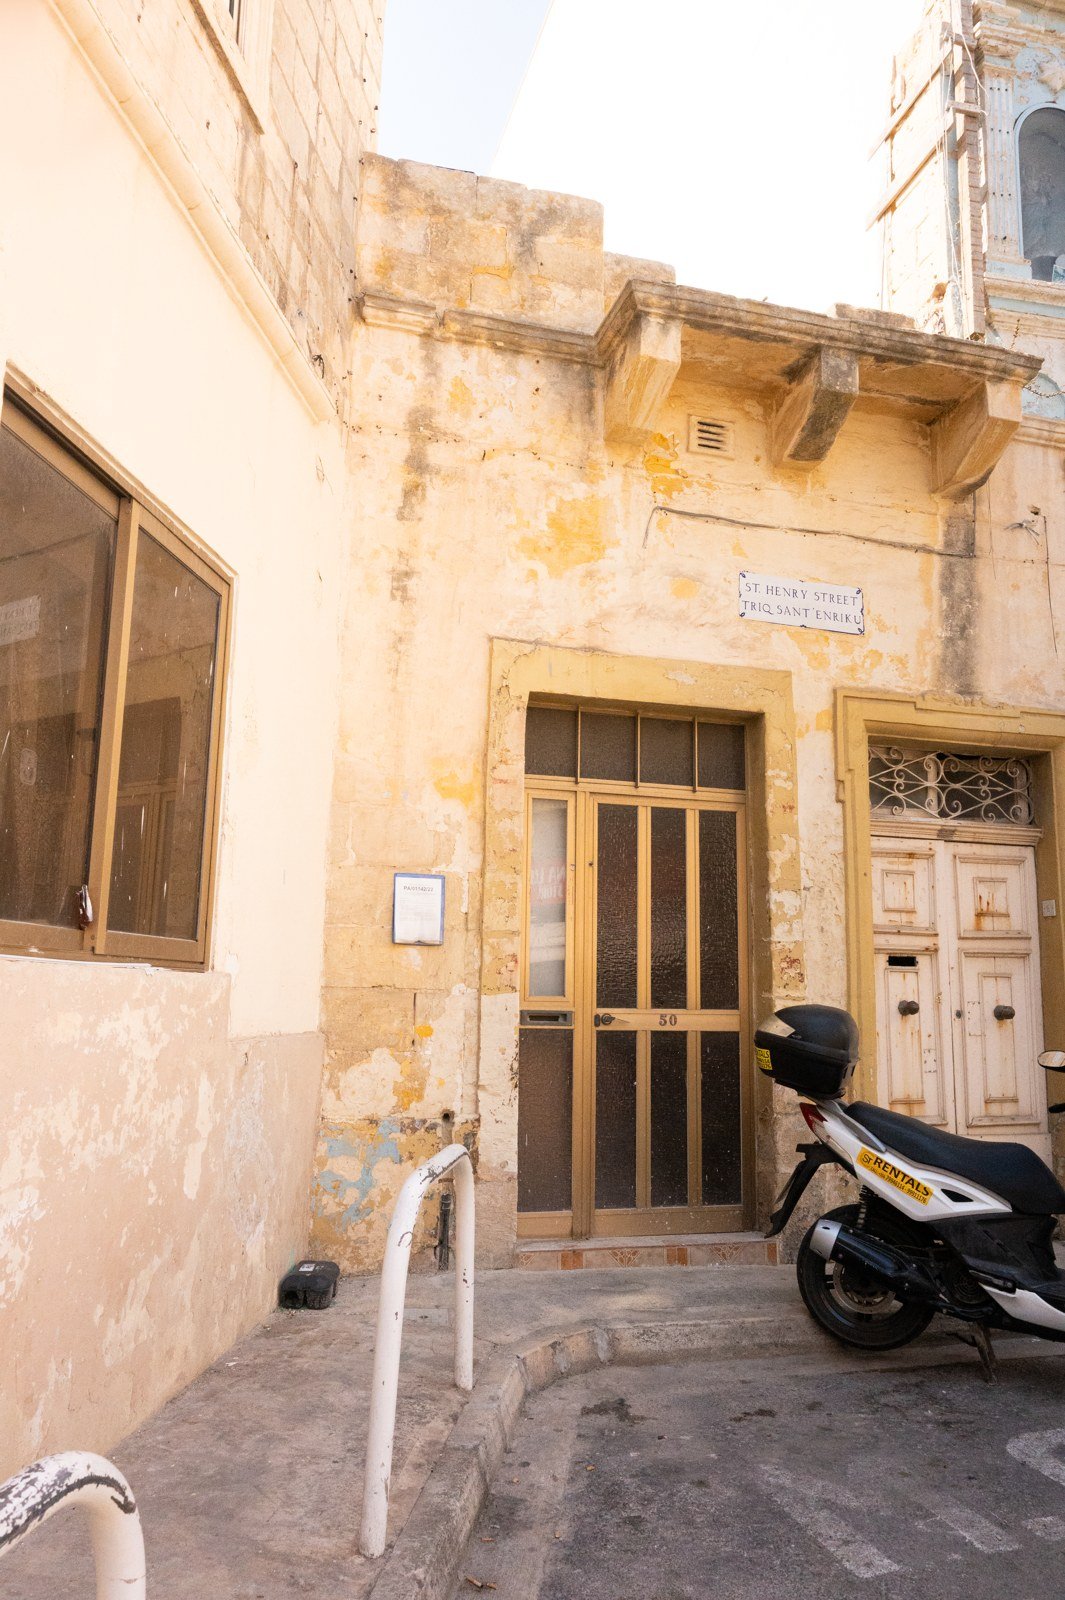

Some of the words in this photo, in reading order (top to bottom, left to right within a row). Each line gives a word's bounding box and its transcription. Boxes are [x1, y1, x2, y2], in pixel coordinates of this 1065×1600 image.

[745, 582, 761, 593] ST.
[766, 585, 808, 600] HENRY
[814, 591, 858, 606] STREET
[741, 600, 774, 615] TRIQ
[659, 1014, 678, 1026] 50
[873, 1156, 930, 1197] RENTALS
